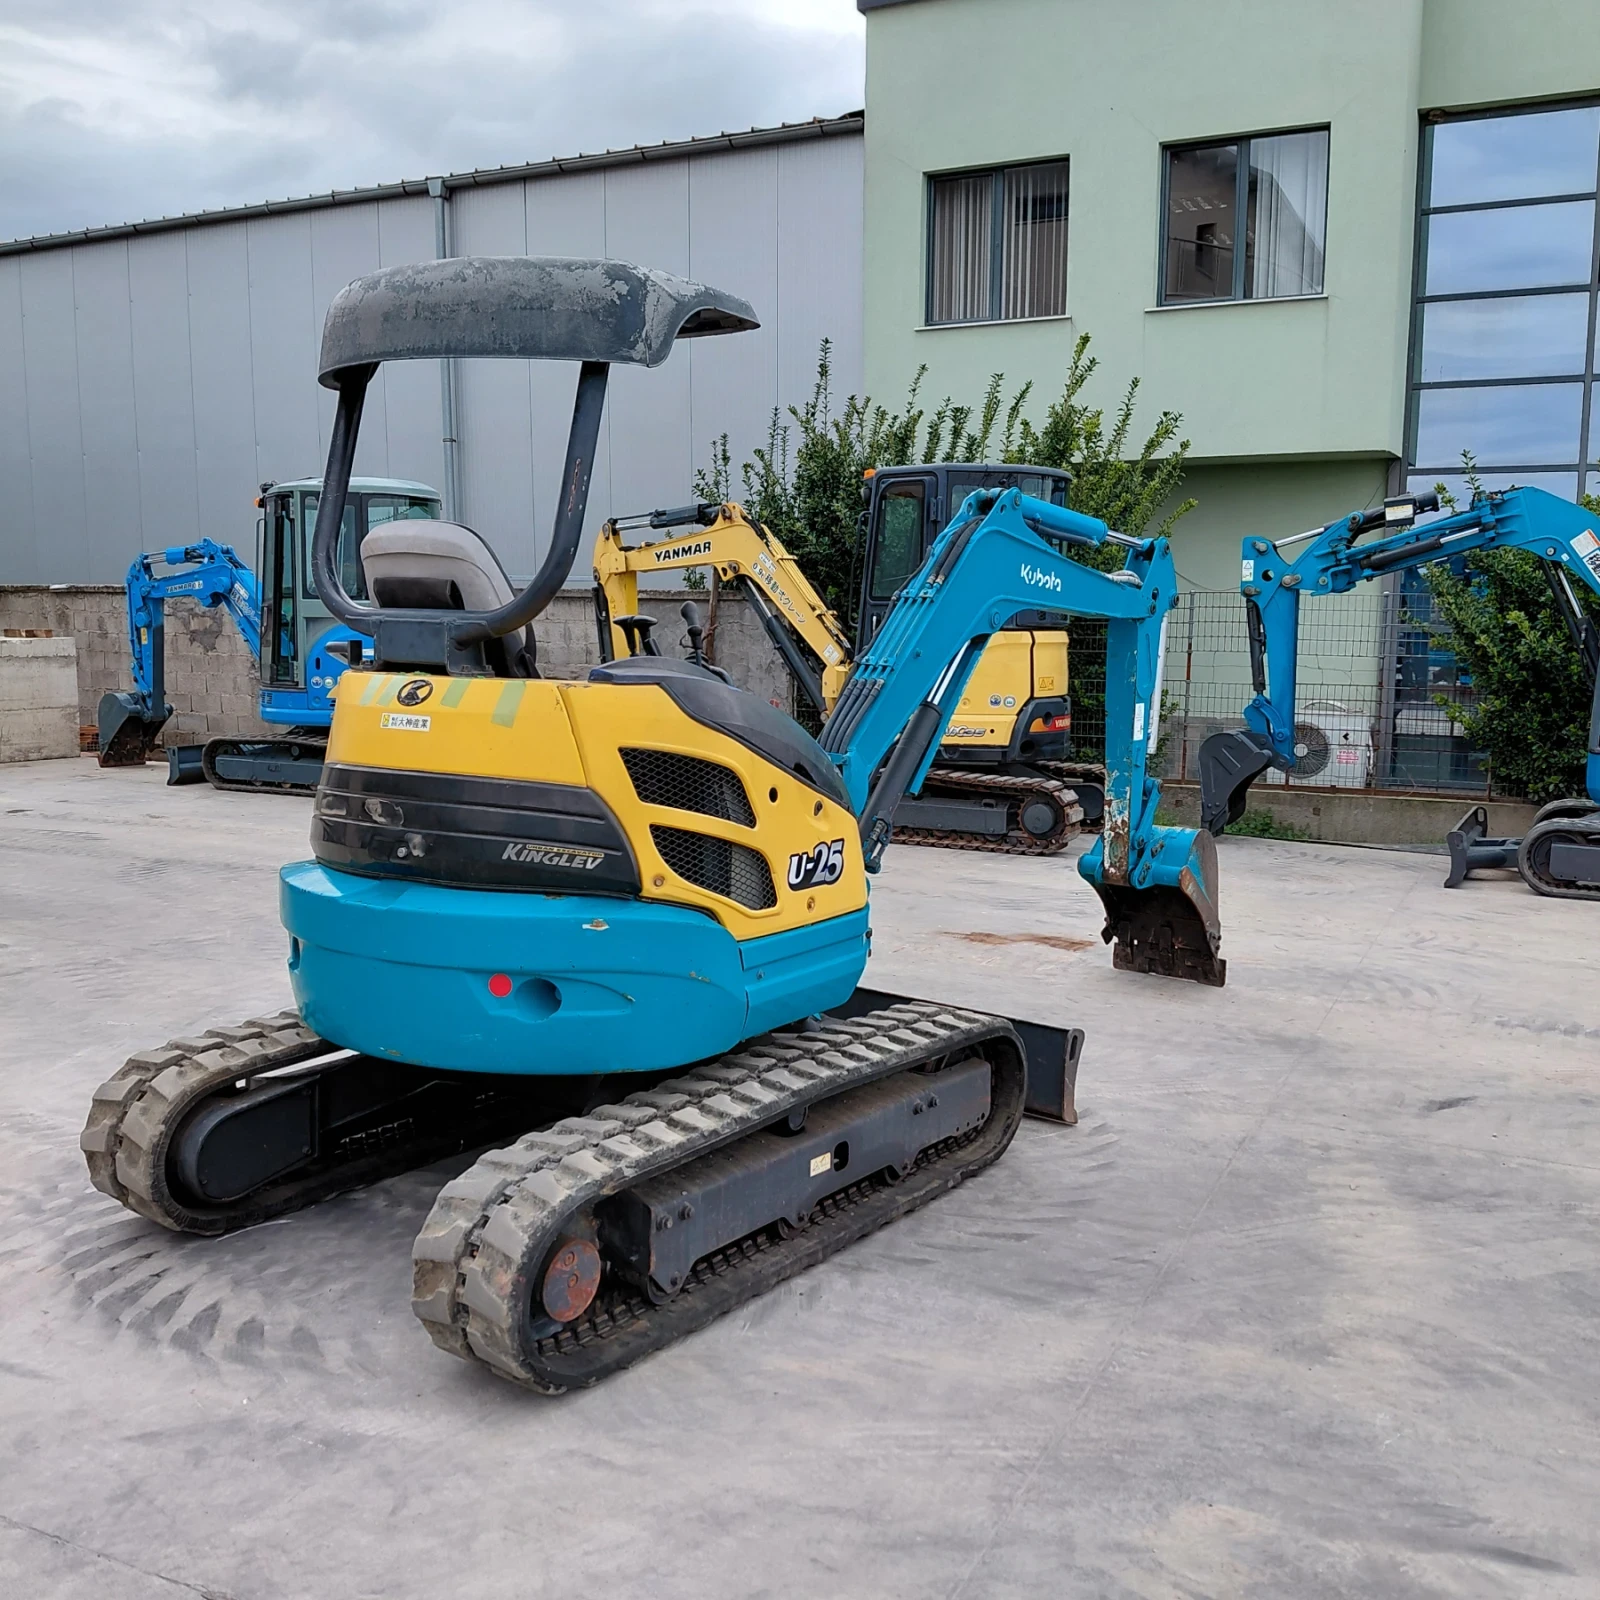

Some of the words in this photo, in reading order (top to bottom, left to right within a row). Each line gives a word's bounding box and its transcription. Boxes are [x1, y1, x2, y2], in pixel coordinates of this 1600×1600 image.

[654, 541, 712, 562] YANMAR
[1020, 563, 1061, 592] Kubota
[501, 843, 604, 870] KINGLEV
[787, 839, 844, 889] U-25
